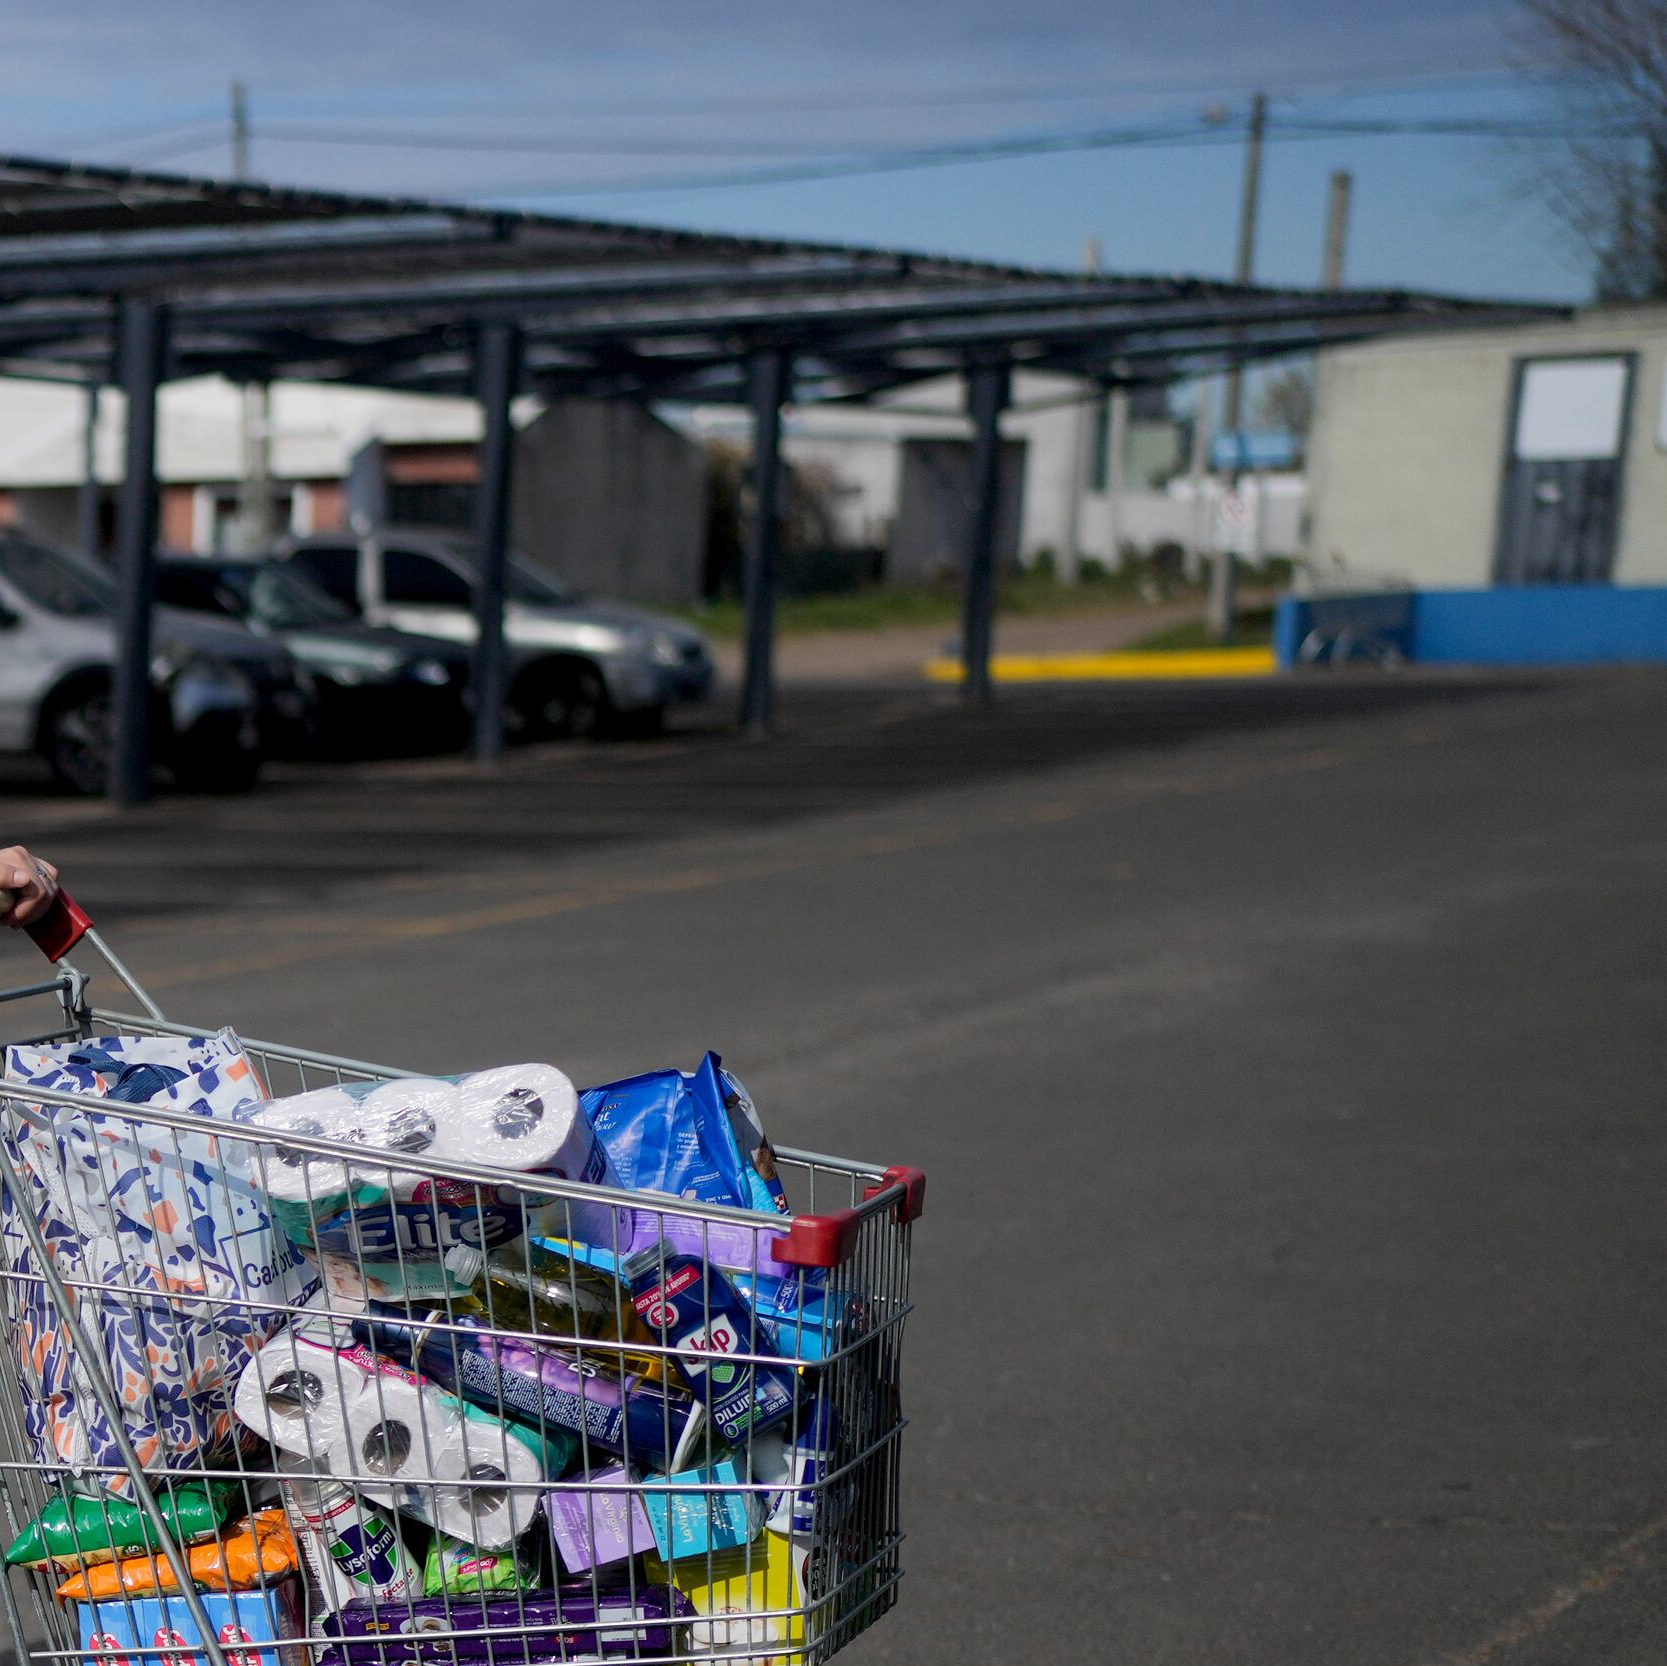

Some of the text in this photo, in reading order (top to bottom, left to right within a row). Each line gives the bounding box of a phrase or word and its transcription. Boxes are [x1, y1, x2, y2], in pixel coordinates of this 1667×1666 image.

[345, 1212, 507, 1254] Elite
[766, 1400, 779, 1413] 500
[337, 1530, 393, 1572] Lysoform
